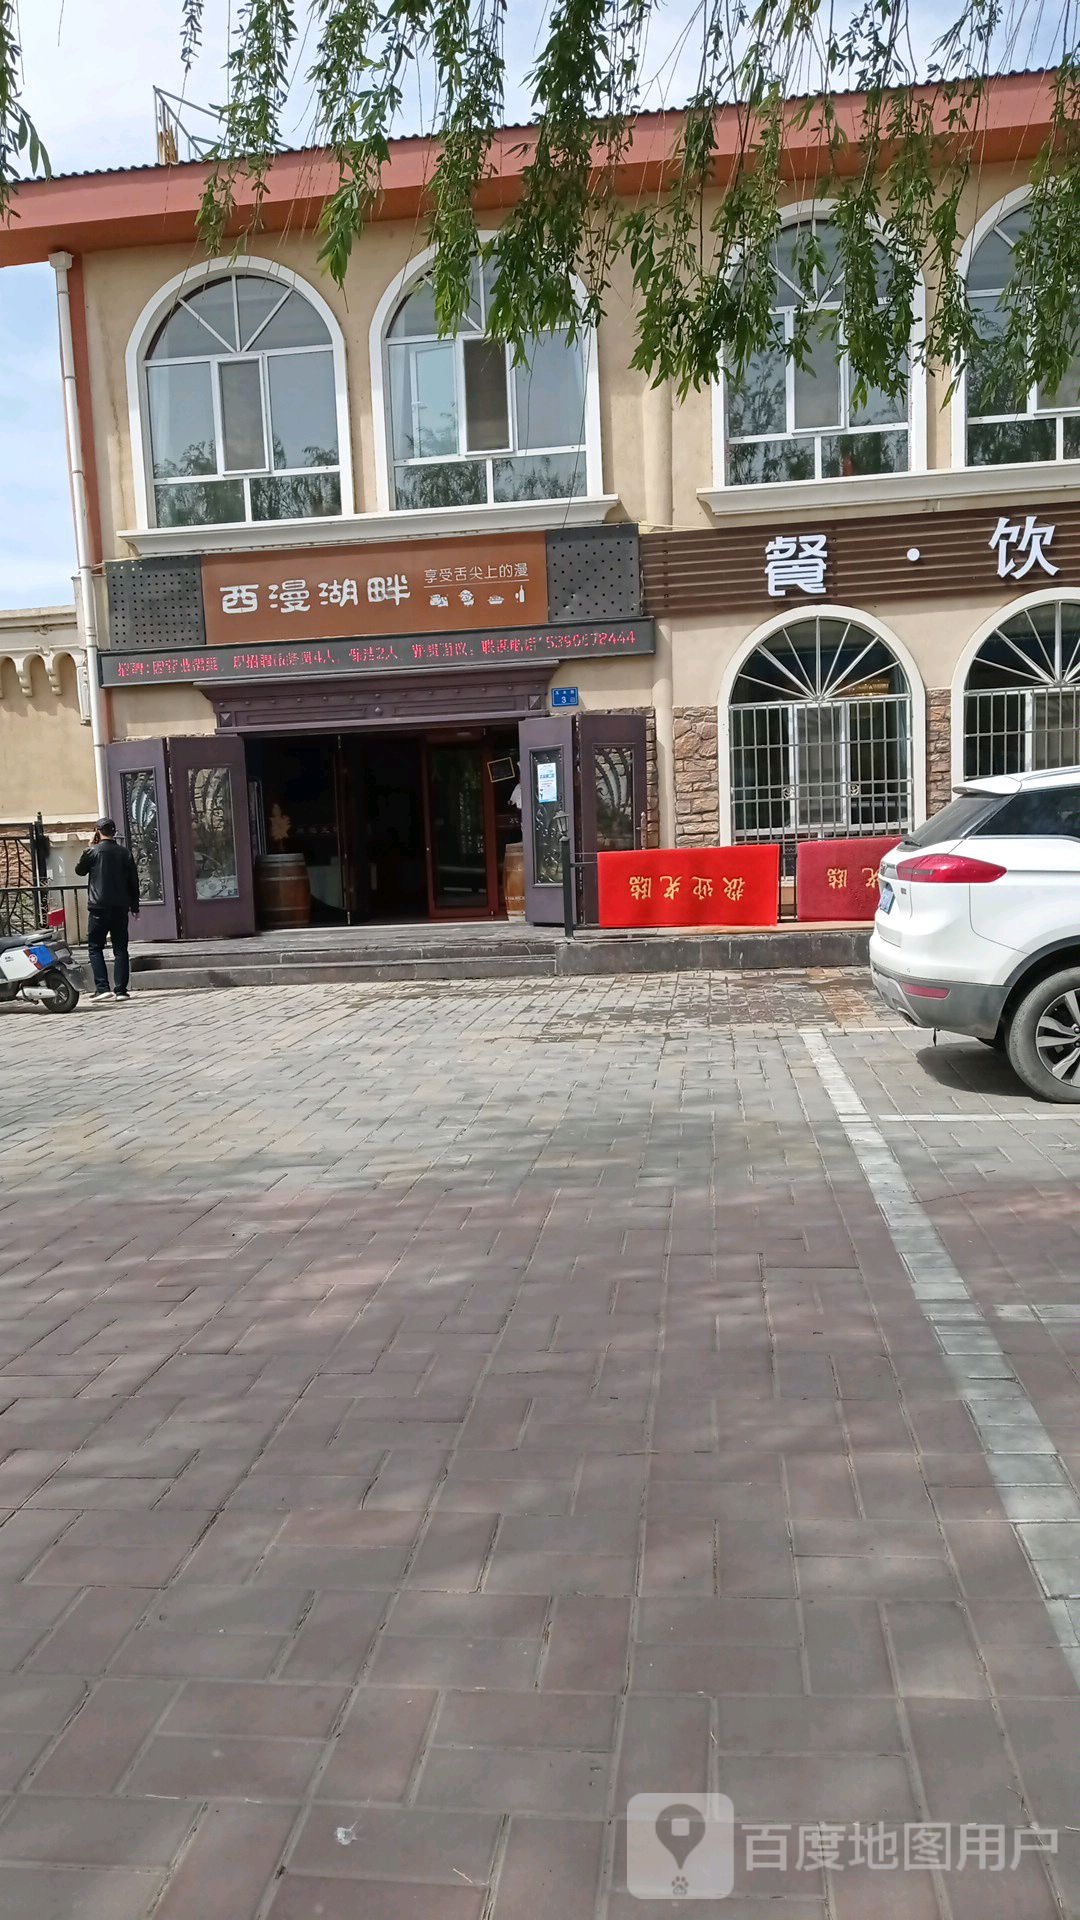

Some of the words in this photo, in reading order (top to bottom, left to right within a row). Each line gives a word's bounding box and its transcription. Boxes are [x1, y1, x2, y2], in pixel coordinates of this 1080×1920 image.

[423, 562, 530, 584] 享受舌尖上的漫
[219, 574, 411, 614] 西漫湖畔
